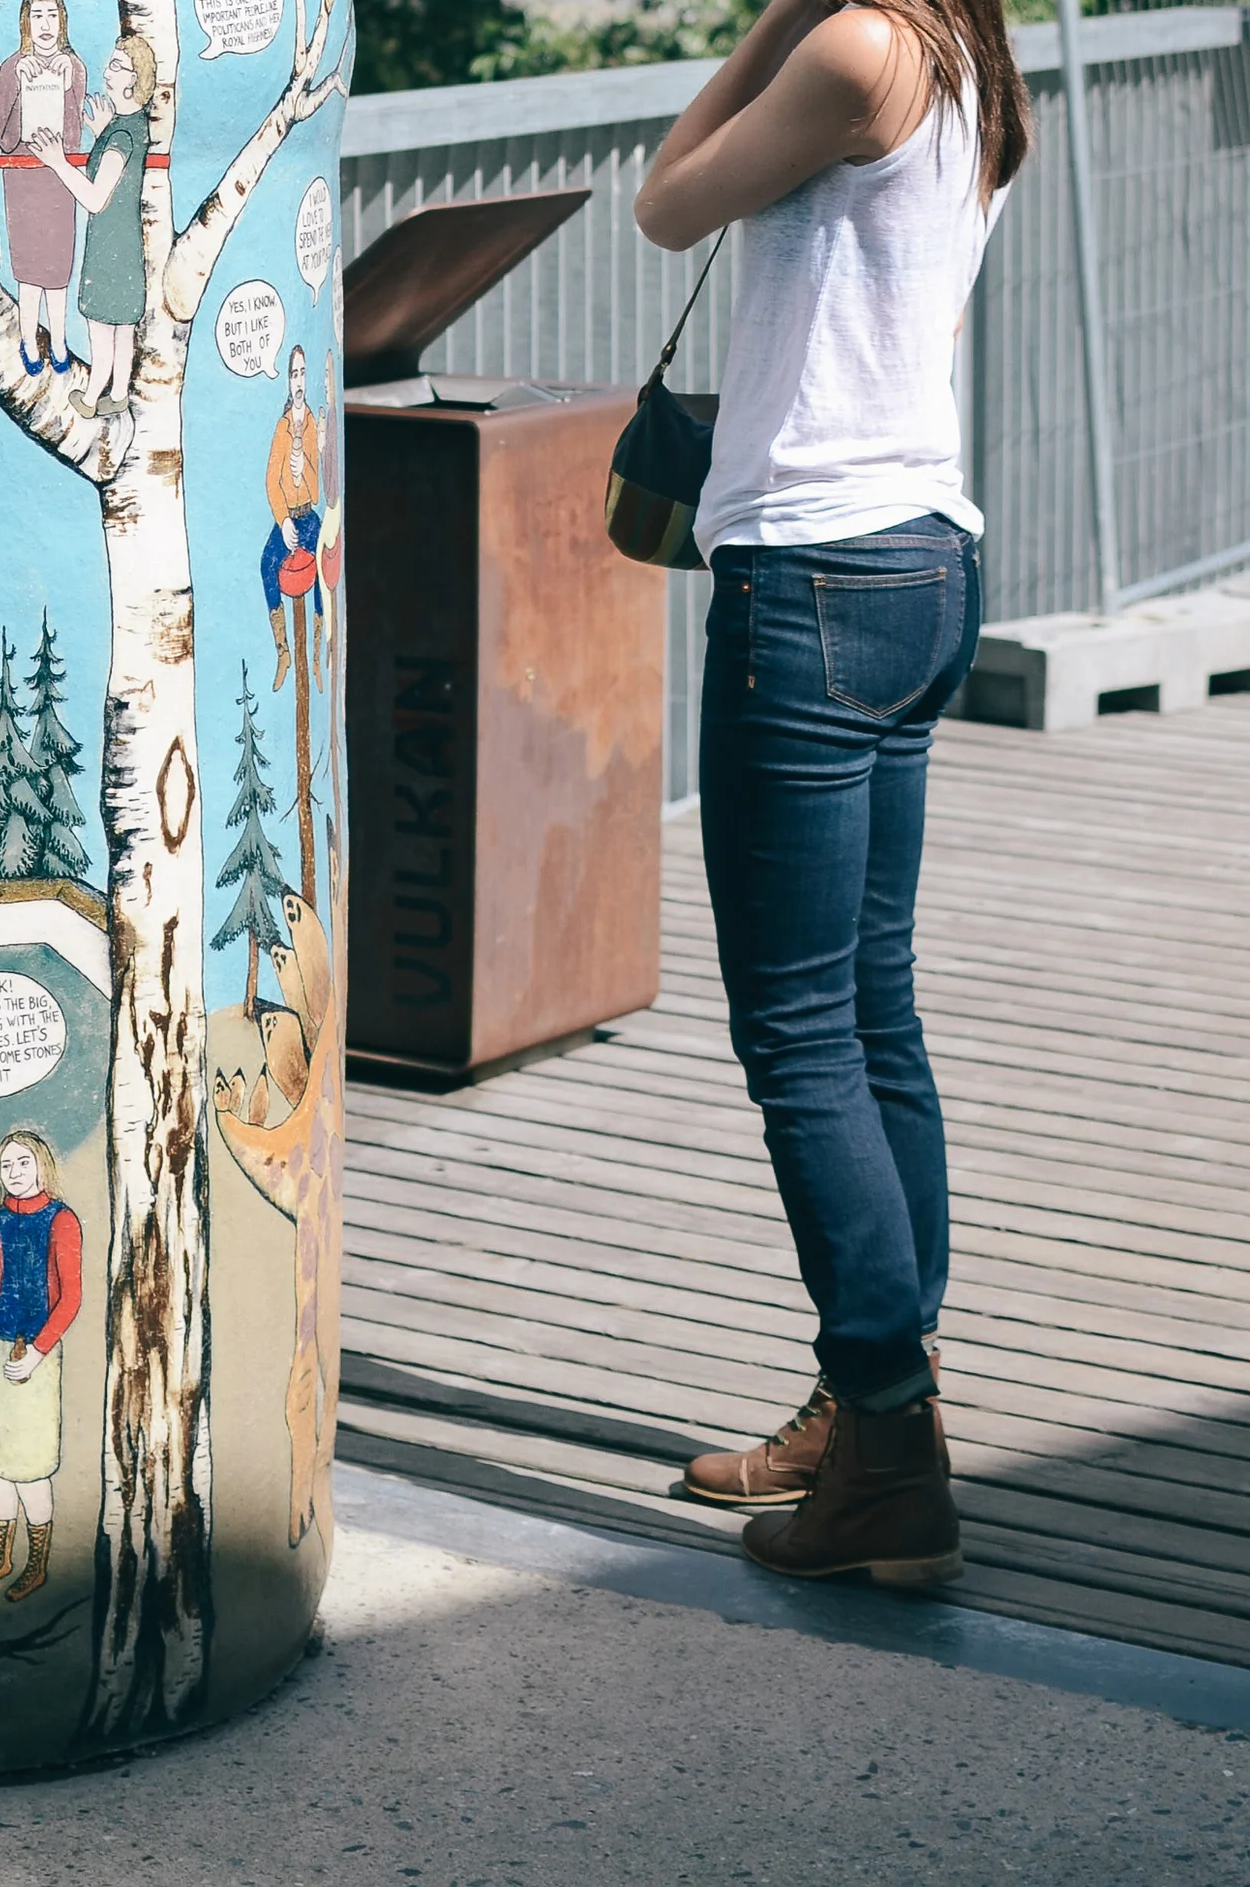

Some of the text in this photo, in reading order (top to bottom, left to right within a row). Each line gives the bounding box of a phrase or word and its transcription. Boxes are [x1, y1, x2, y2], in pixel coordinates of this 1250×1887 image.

[203, 8, 241, 23] IMPORTANT
[222, 36, 245, 48] ROYAL
[225, 321, 242, 337] BUT
[259, 334, 271, 349] OF
[243, 356, 262, 372] YOU
[392, 655, 454, 1008] VULKAN
[5, 997, 25, 1010] THE
[7, 1013, 35, 1028] WITH
[39, 1010, 59, 1023] THE
[17, 1024, 47, 1045] LET'S
[24, 1043, 62, 1060] STONES
[0, 1069, 11, 1082] IT
